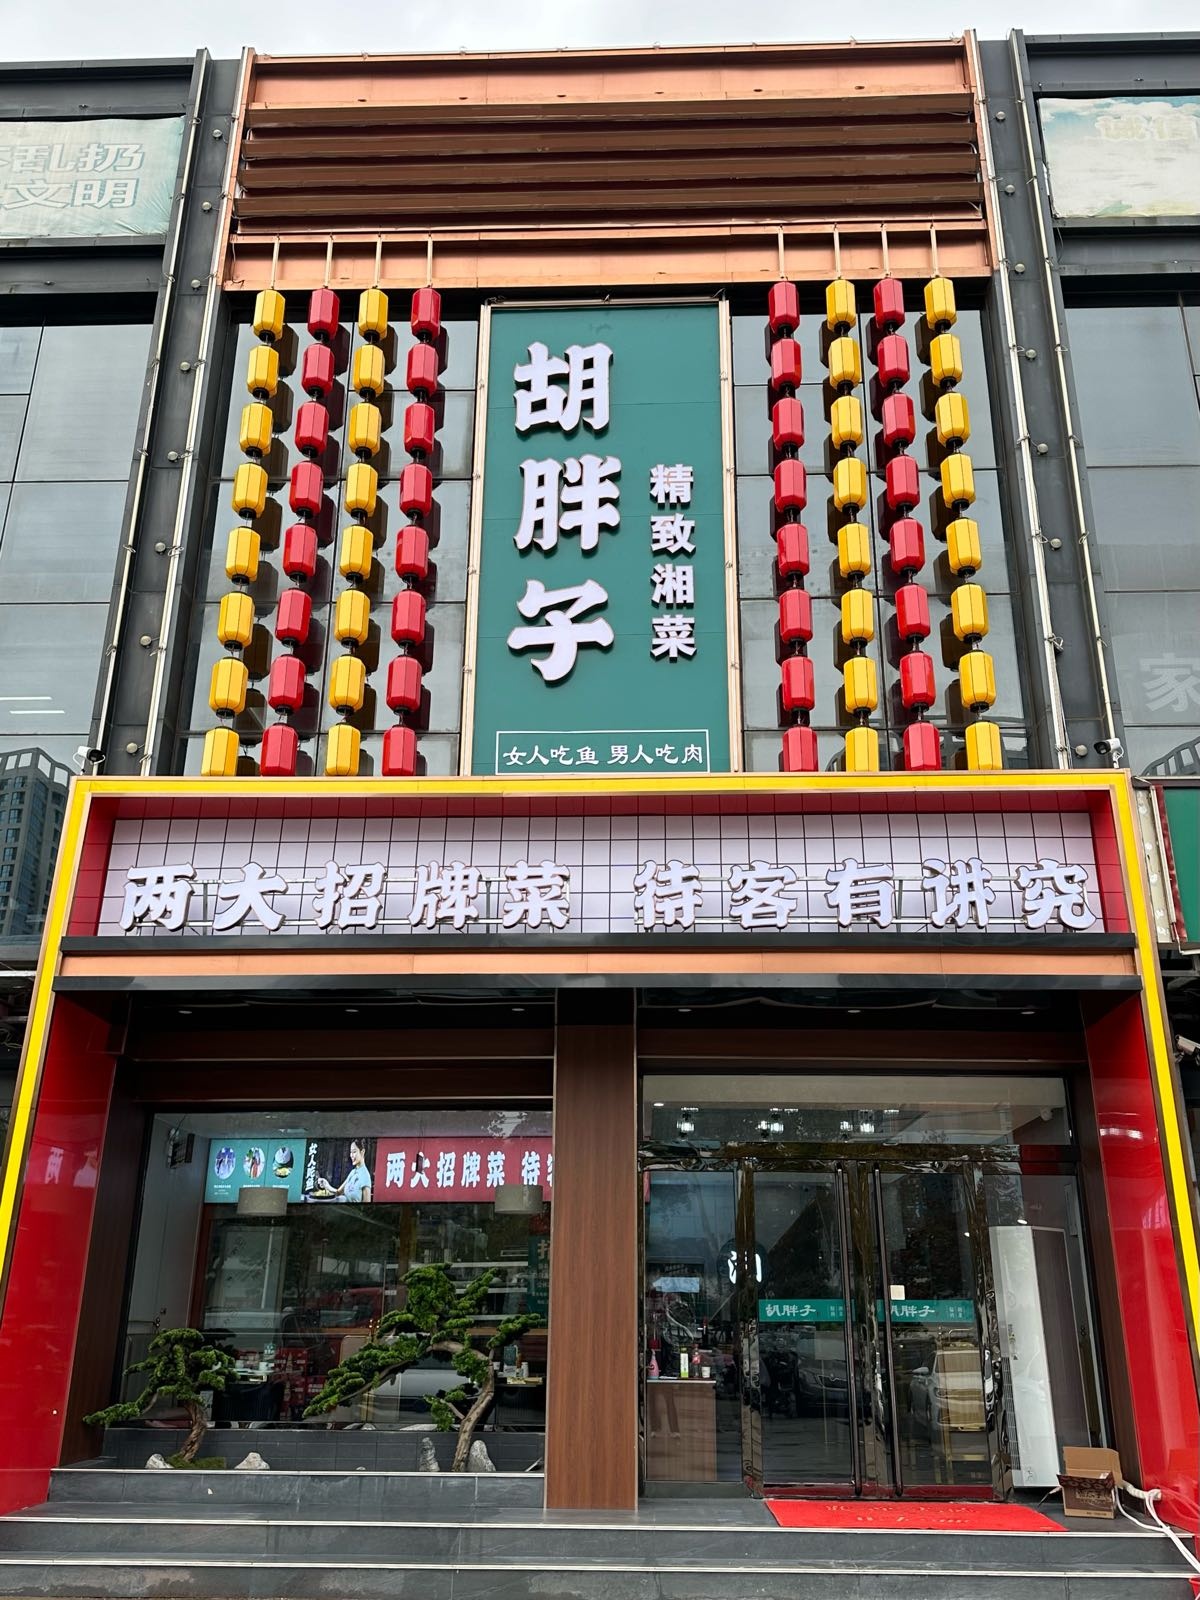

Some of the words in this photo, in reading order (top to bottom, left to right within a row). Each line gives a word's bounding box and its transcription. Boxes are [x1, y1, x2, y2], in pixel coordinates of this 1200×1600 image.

[0, 178, 141, 210] 文明
[507, 341, 622, 683] 胡胖子
[649, 463, 697, 661] 精致湘菜
[502, 744, 600, 766] 女人吃鱼
[606, 743, 703, 765] 男人吃肉
[117, 859, 571, 931] 两大招牌菜
[633, 857, 1097, 930] 待客有讲究
